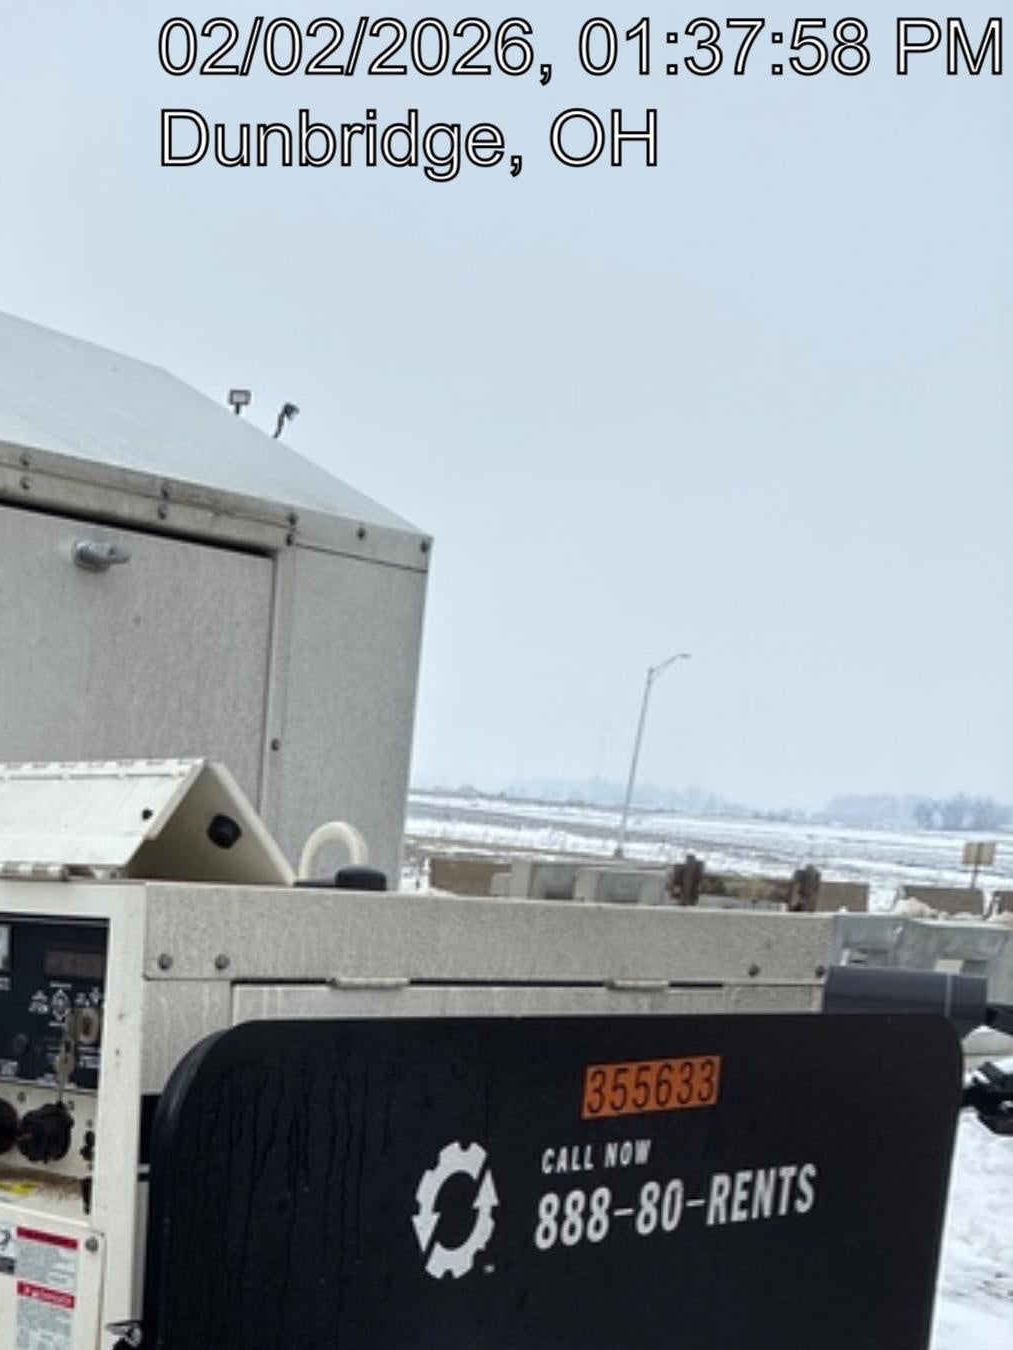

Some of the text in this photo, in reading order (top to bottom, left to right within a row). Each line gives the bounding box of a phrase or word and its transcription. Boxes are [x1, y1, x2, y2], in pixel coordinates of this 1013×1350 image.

[587, 1058, 716, 1114] 355633
[541, 1139, 652, 1174] CALL NOW
[534, 1162, 817, 1250] 888-80-RENTS
